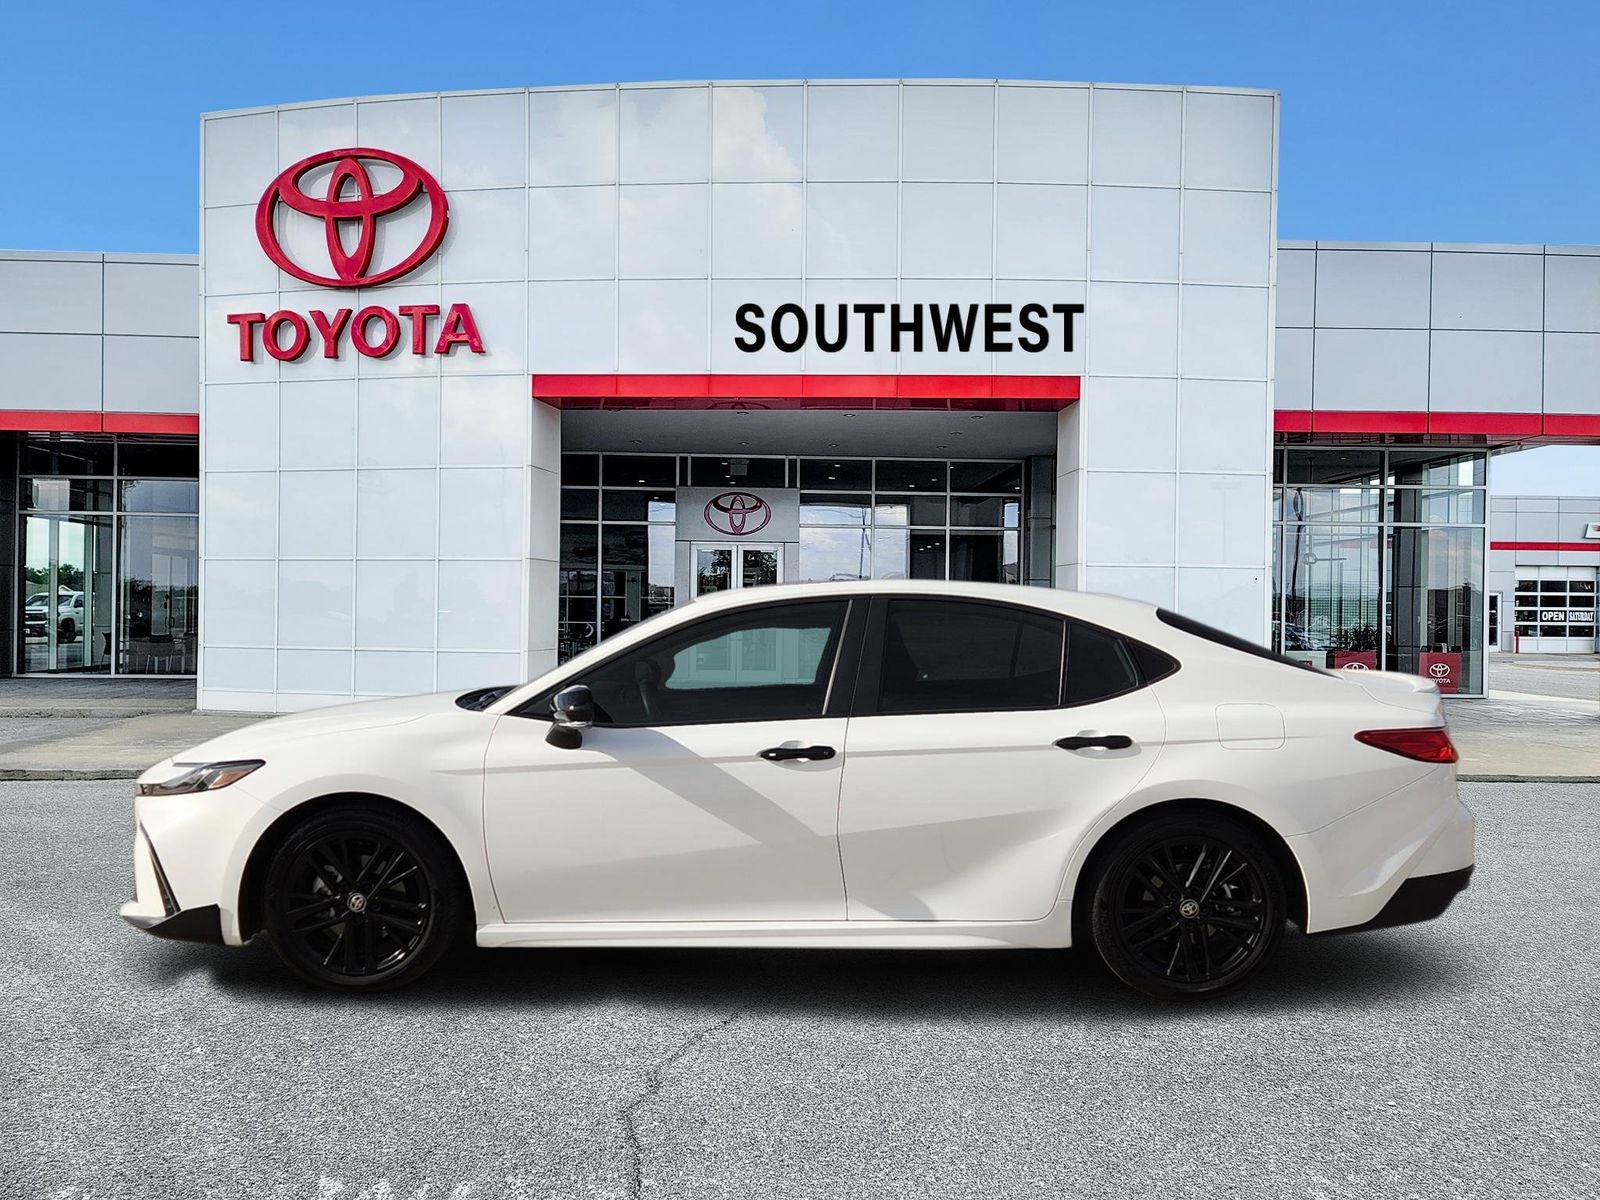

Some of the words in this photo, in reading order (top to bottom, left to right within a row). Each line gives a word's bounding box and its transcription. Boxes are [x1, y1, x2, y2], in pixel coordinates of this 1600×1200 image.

[227, 303, 486, 362] TOYOTA
[734, 302, 1085, 353] SOUTHWEST
[1542, 611, 1565, 621] OPEN
[1569, 611, 1594, 621] SATURDAY
